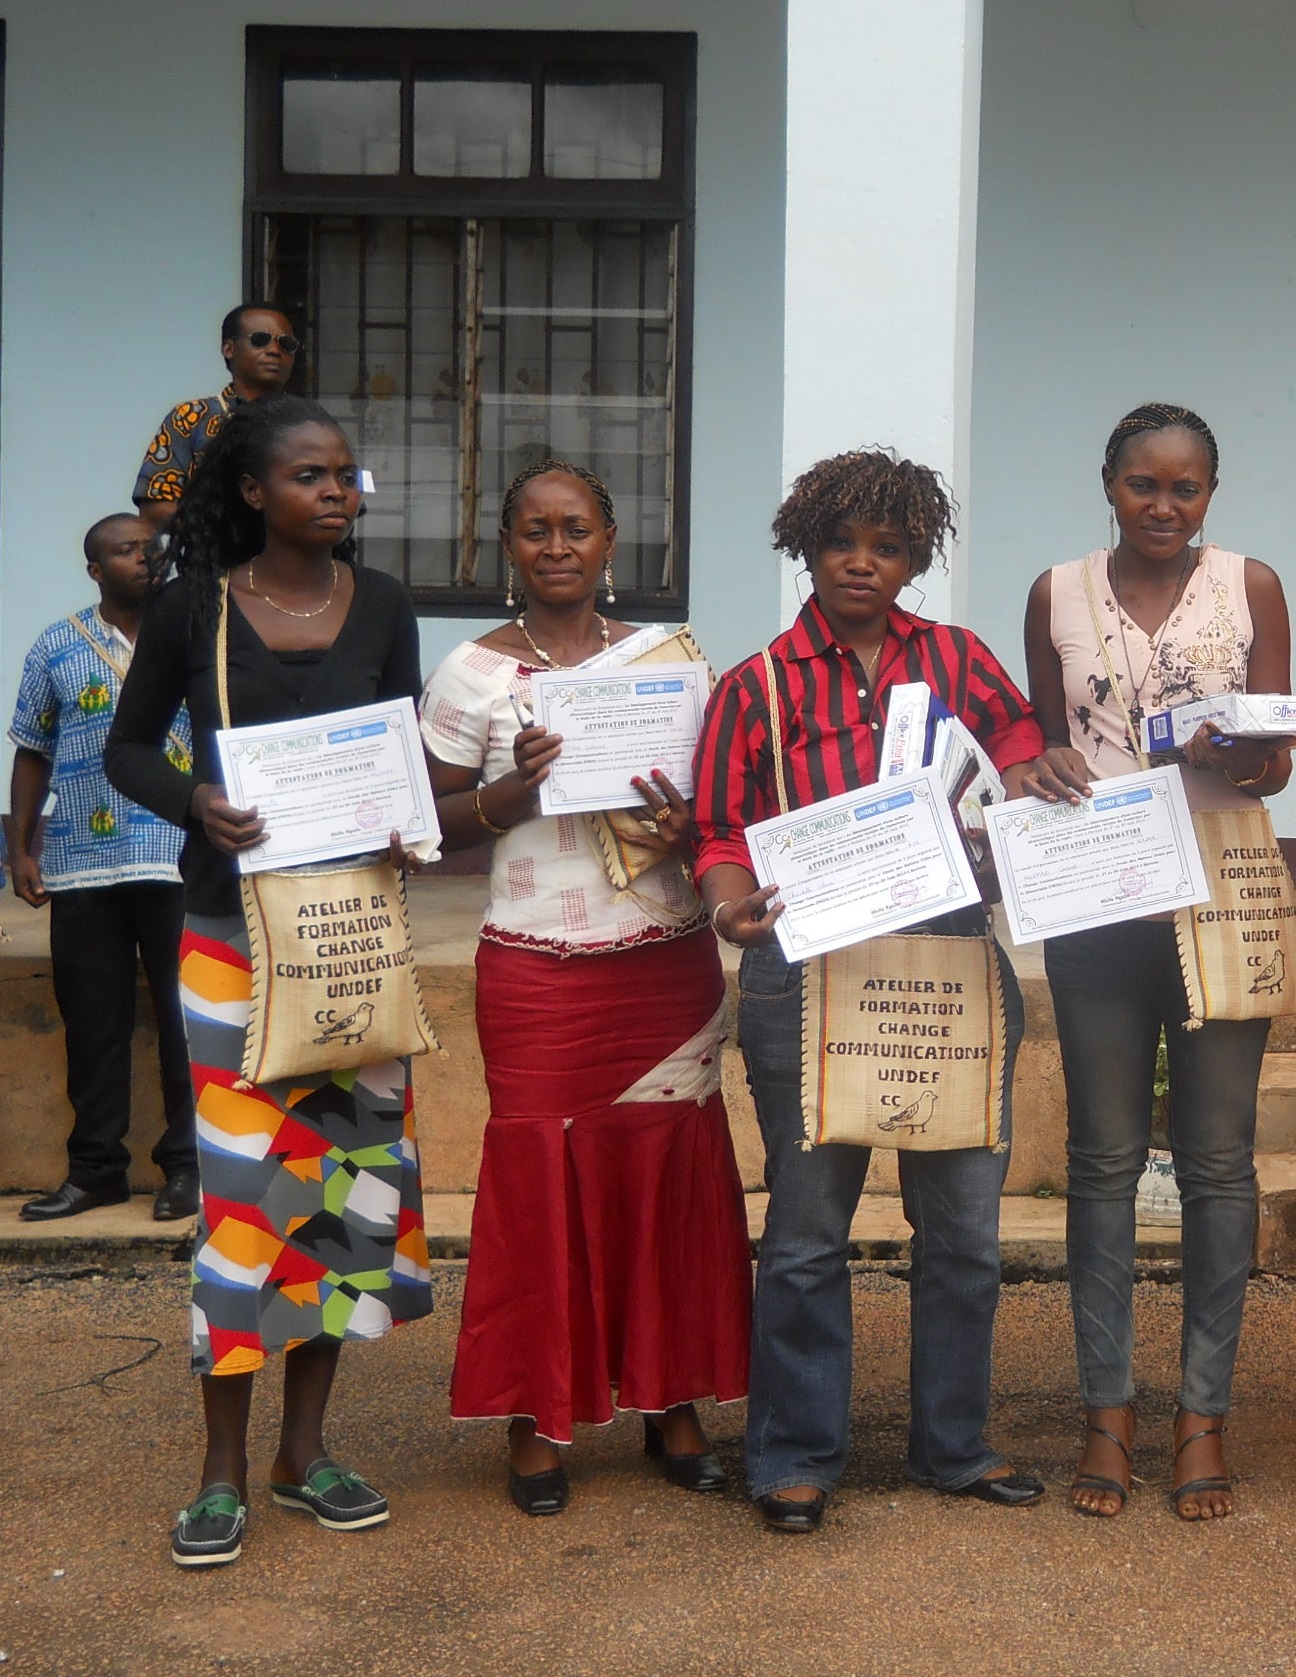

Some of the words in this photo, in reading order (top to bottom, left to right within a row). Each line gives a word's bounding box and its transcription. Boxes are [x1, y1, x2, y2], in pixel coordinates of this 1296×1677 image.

[1273, 704, 1296, 718] Office
[1094, 800, 1116, 809] UNDEF
[856, 807, 876, 818] UNDEF
[1029, 811, 1048, 826] CHANGE
[790, 826, 809, 841] CHANGE
[809, 810, 852, 834] COMMUNICATIONS
[1044, 839, 1090, 855] ATTESTATION
[1102, 827, 1141, 842] FORMATION
[808, 850, 854, 870] ATTESTATION
[866, 832, 906, 851] FORMATION
[1222, 848, 1268, 860] ATELIER
[1220, 866, 1284, 880] FORMATION
[1240, 886, 1282, 900] CHANGE
[298, 898, 362, 918] ATELIER
[371, 894, 387, 909] DE
[298, 914, 392, 939] FORMATION
[1242, 930, 1280, 942] UNDEF
[316, 936, 384, 958] CHANGE
[1247, 956, 1262, 968] CC
[327, 978, 382, 998] UNDEF
[863, 979, 936, 994] ATELIER
[942, 982, 963, 994] DE
[860, 1000, 964, 1016] FORMATION
[314, 1009, 336, 1024] CC
[878, 1022, 950, 1037] CHANGE
[826, 1042, 988, 1060] COMMUNICATIONS
[878, 1069, 940, 1084] UNDEF
[880, 1094, 901, 1108] CC
